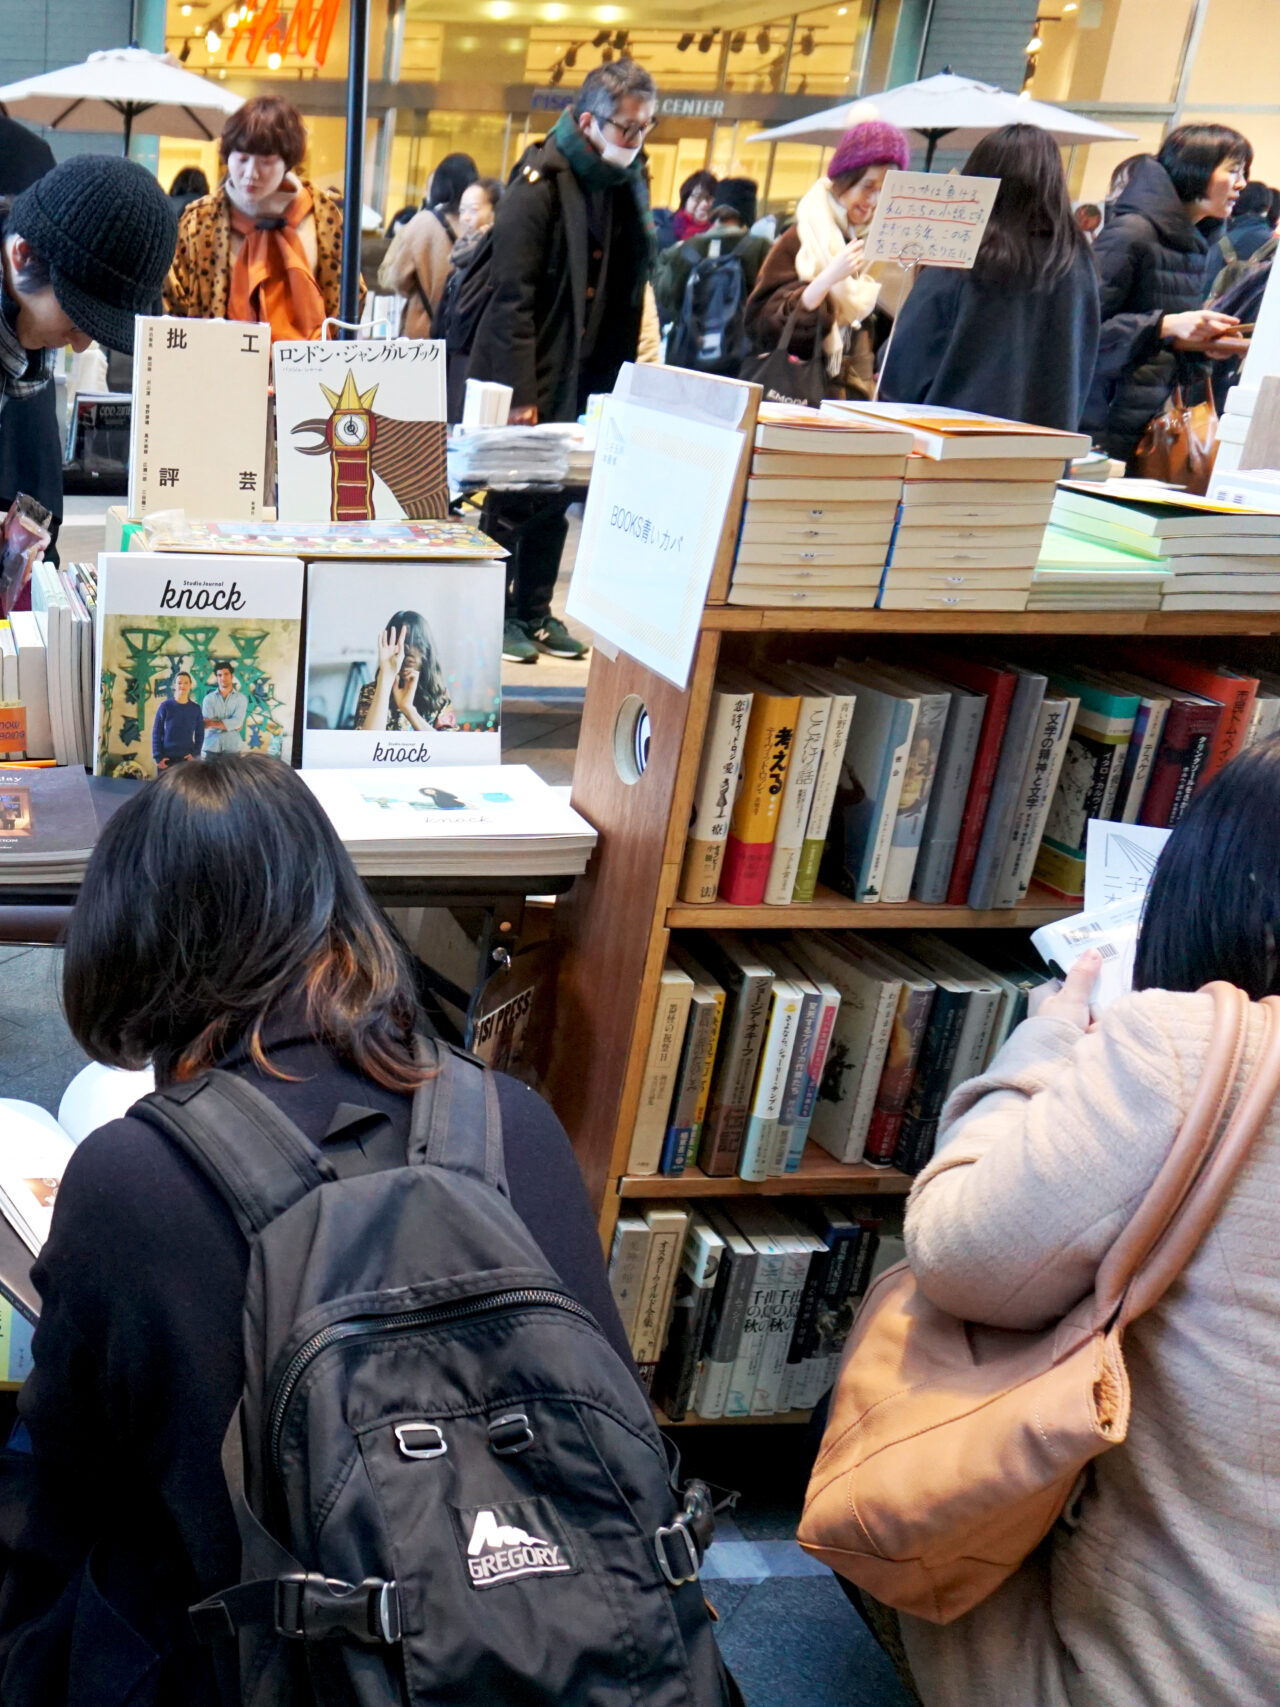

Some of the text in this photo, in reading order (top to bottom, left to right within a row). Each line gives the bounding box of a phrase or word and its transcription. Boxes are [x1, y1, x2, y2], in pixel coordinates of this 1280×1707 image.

[662, 98, 725, 115] CENTER
[166, 327, 188, 350] 批
[279, 343, 441, 364] ロンドン・ジャングルブック
[159, 467, 180, 488] 評
[238, 471, 258, 492] 芸
[159, 579, 247, 612] knock
[372, 742, 431, 763] knock
[795, 710, 825, 786] ここだけの話
[467, 1545, 561, 1580] GREGORY
